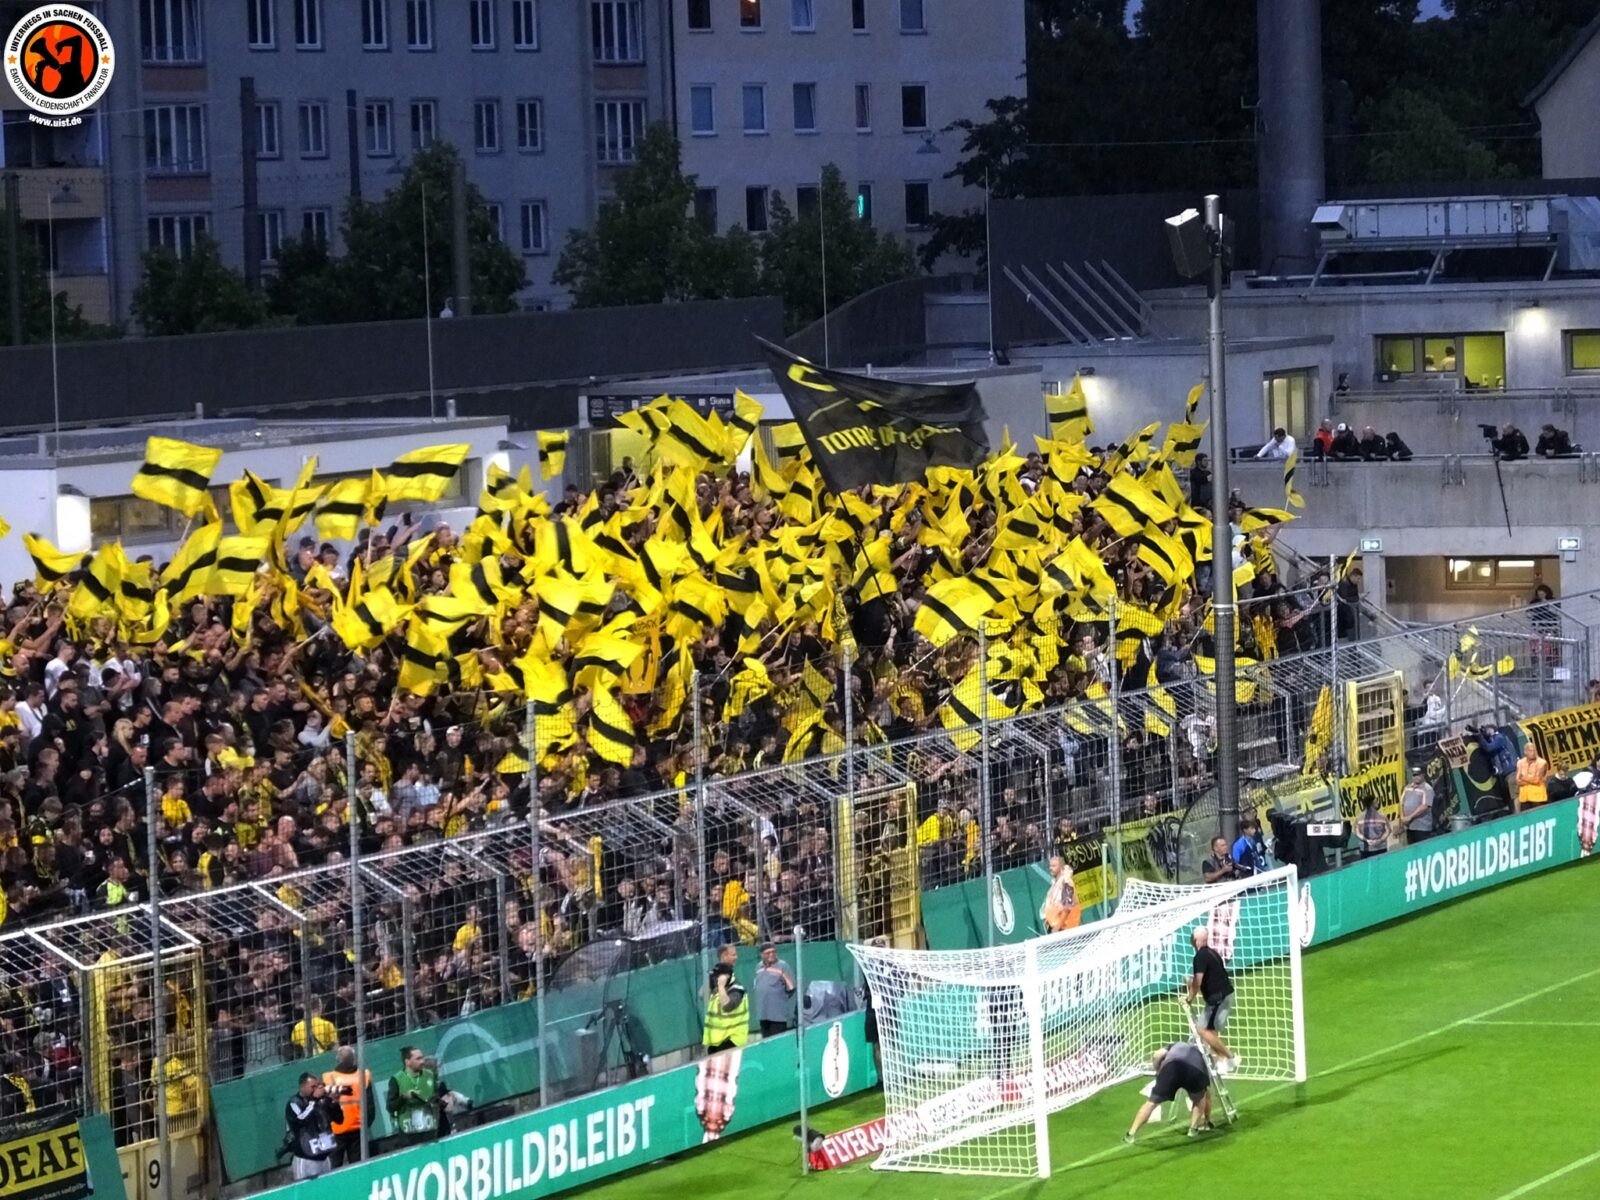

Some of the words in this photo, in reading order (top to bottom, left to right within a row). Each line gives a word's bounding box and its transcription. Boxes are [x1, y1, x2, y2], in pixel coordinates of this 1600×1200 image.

[1075, 840, 1103, 863] SUH
[1405, 818, 1556, 902] #VORBILDBLEIBT
[149, 1160, 160, 1188] 9
